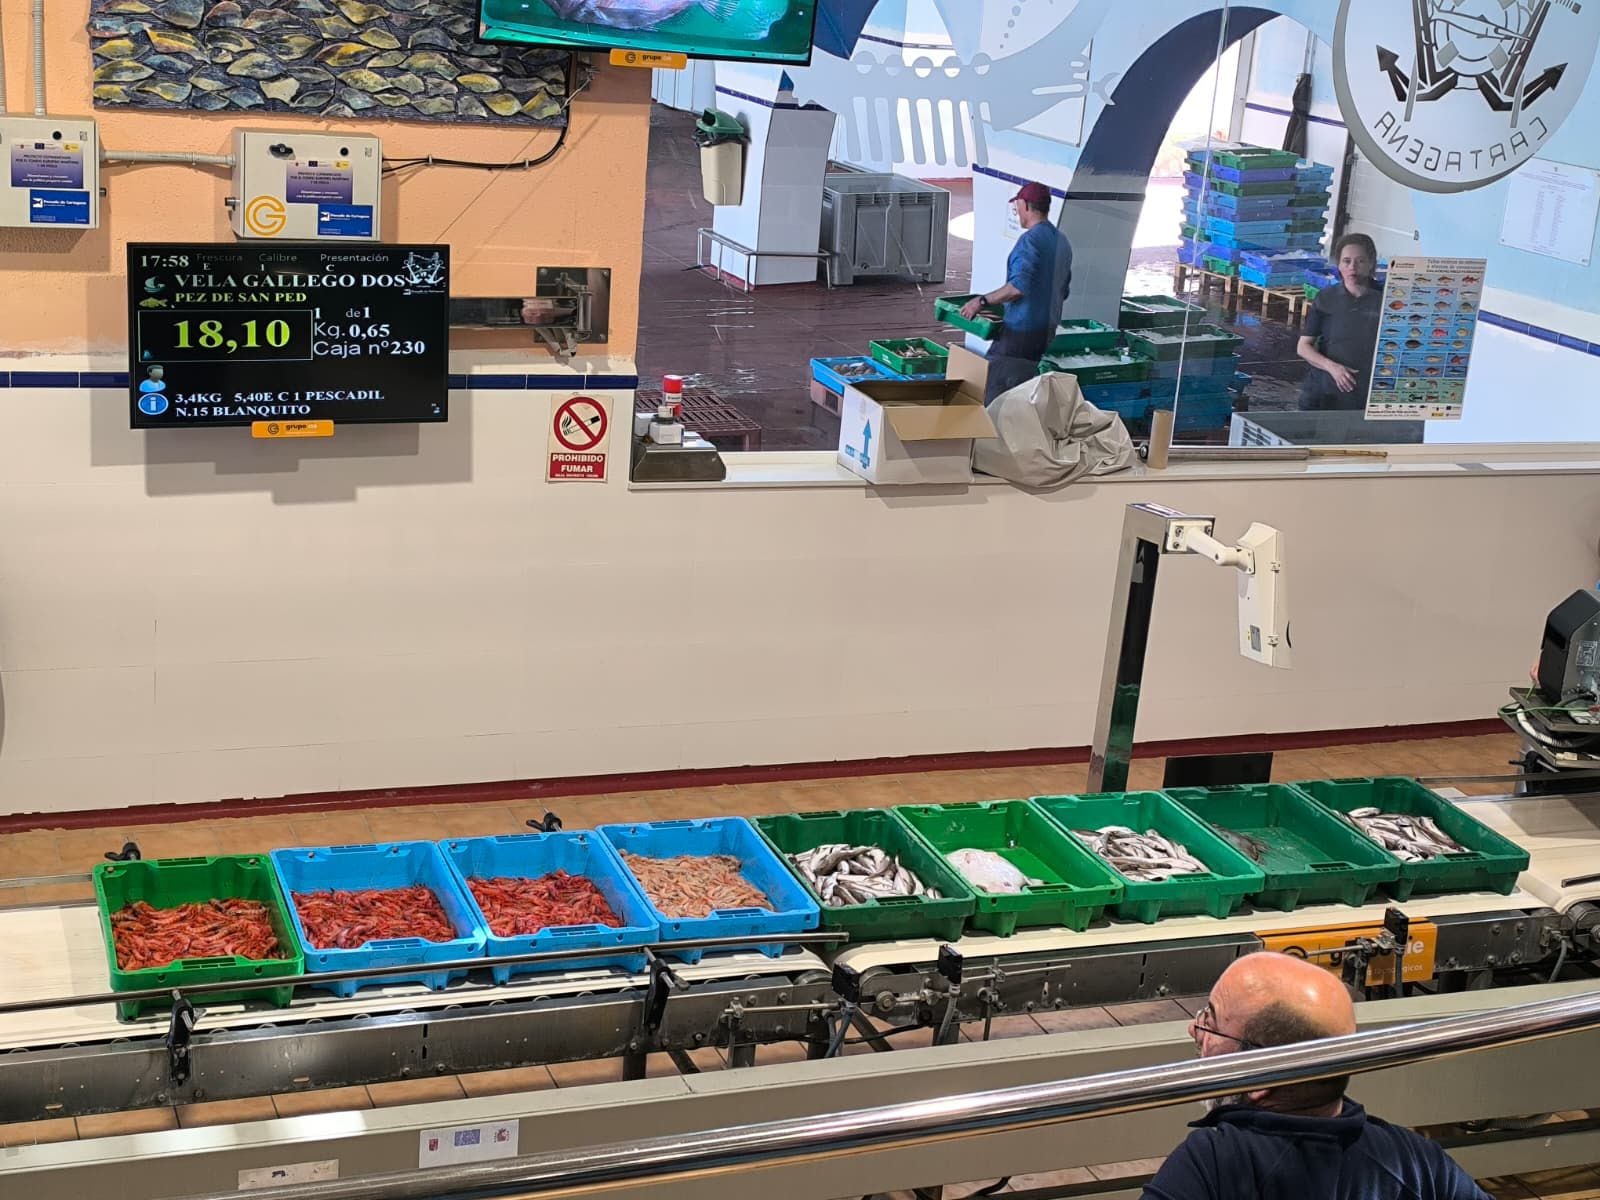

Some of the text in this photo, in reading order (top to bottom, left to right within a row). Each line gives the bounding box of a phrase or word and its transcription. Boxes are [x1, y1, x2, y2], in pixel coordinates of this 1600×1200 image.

[140, 253, 389, 268] 17:58 Frescura Calibre Presentación
[203, 263, 211, 271] E
[325, 264, 335, 272] C
[174, 274, 406, 288] VELA GALLEGO DOS
[175, 292, 307, 303] PEZ DE SAN PED
[314, 306, 370, 319] 1 de 1
[173, 319, 290, 354] 18,10
[314, 321, 391, 340] Kg. 0,65
[313, 340, 361, 359] Caja
[175, 390, 385, 404] 3,4KG 5,40E C 1 PESCADIL
[175, 404, 311, 417] N.15 BLANQUITO
[552, 454, 603, 463] PROHIBIDO
[560, 464, 593, 473] FUMAR
[1406, 940, 1425, 954] ie
